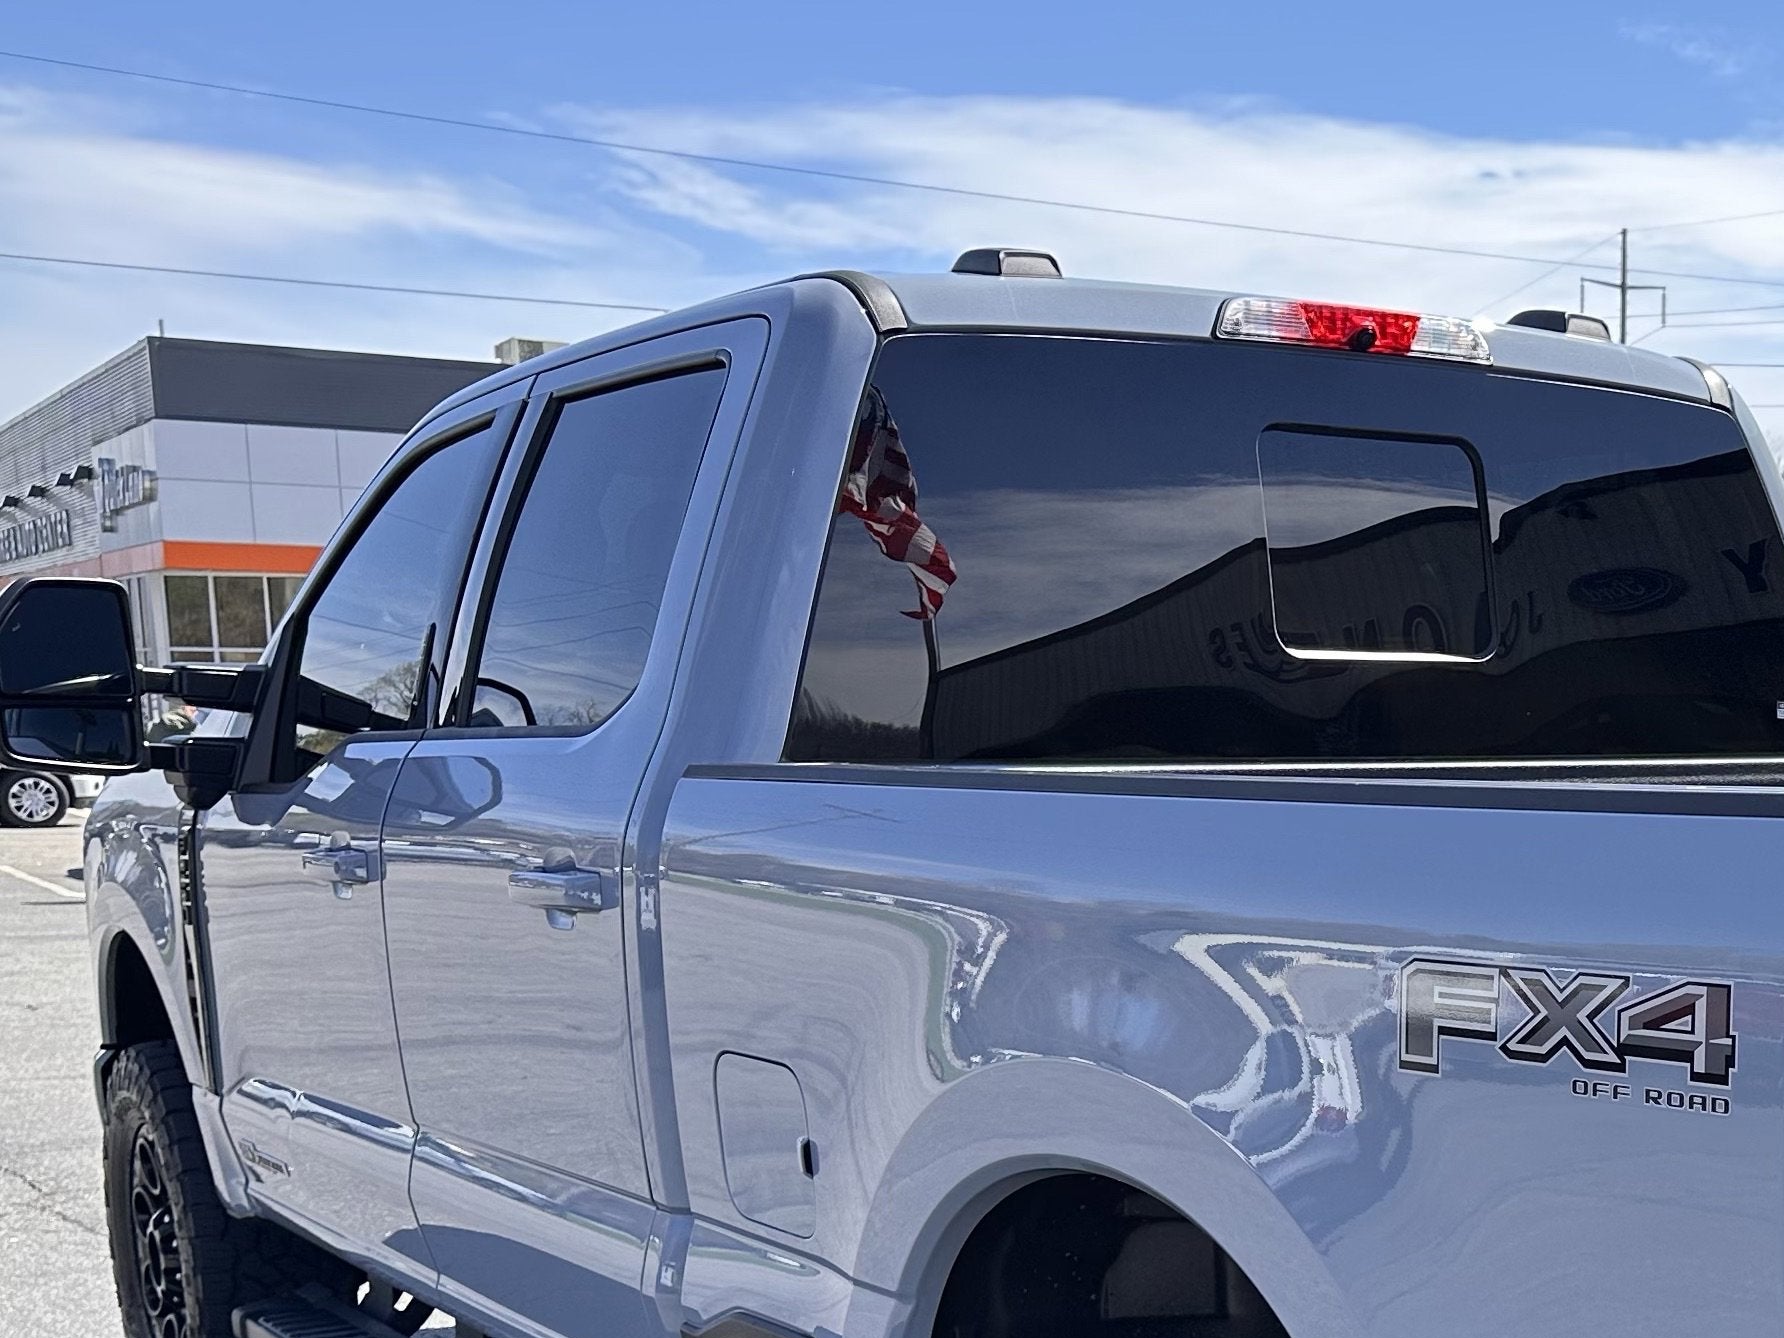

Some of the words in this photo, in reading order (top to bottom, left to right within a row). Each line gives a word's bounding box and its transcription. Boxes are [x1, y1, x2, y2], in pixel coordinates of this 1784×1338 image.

[1398, 954, 1738, 1089] FX4
[1570, 1078, 1632, 1101] OFF
[1644, 1088, 1733, 1117] ROAD
